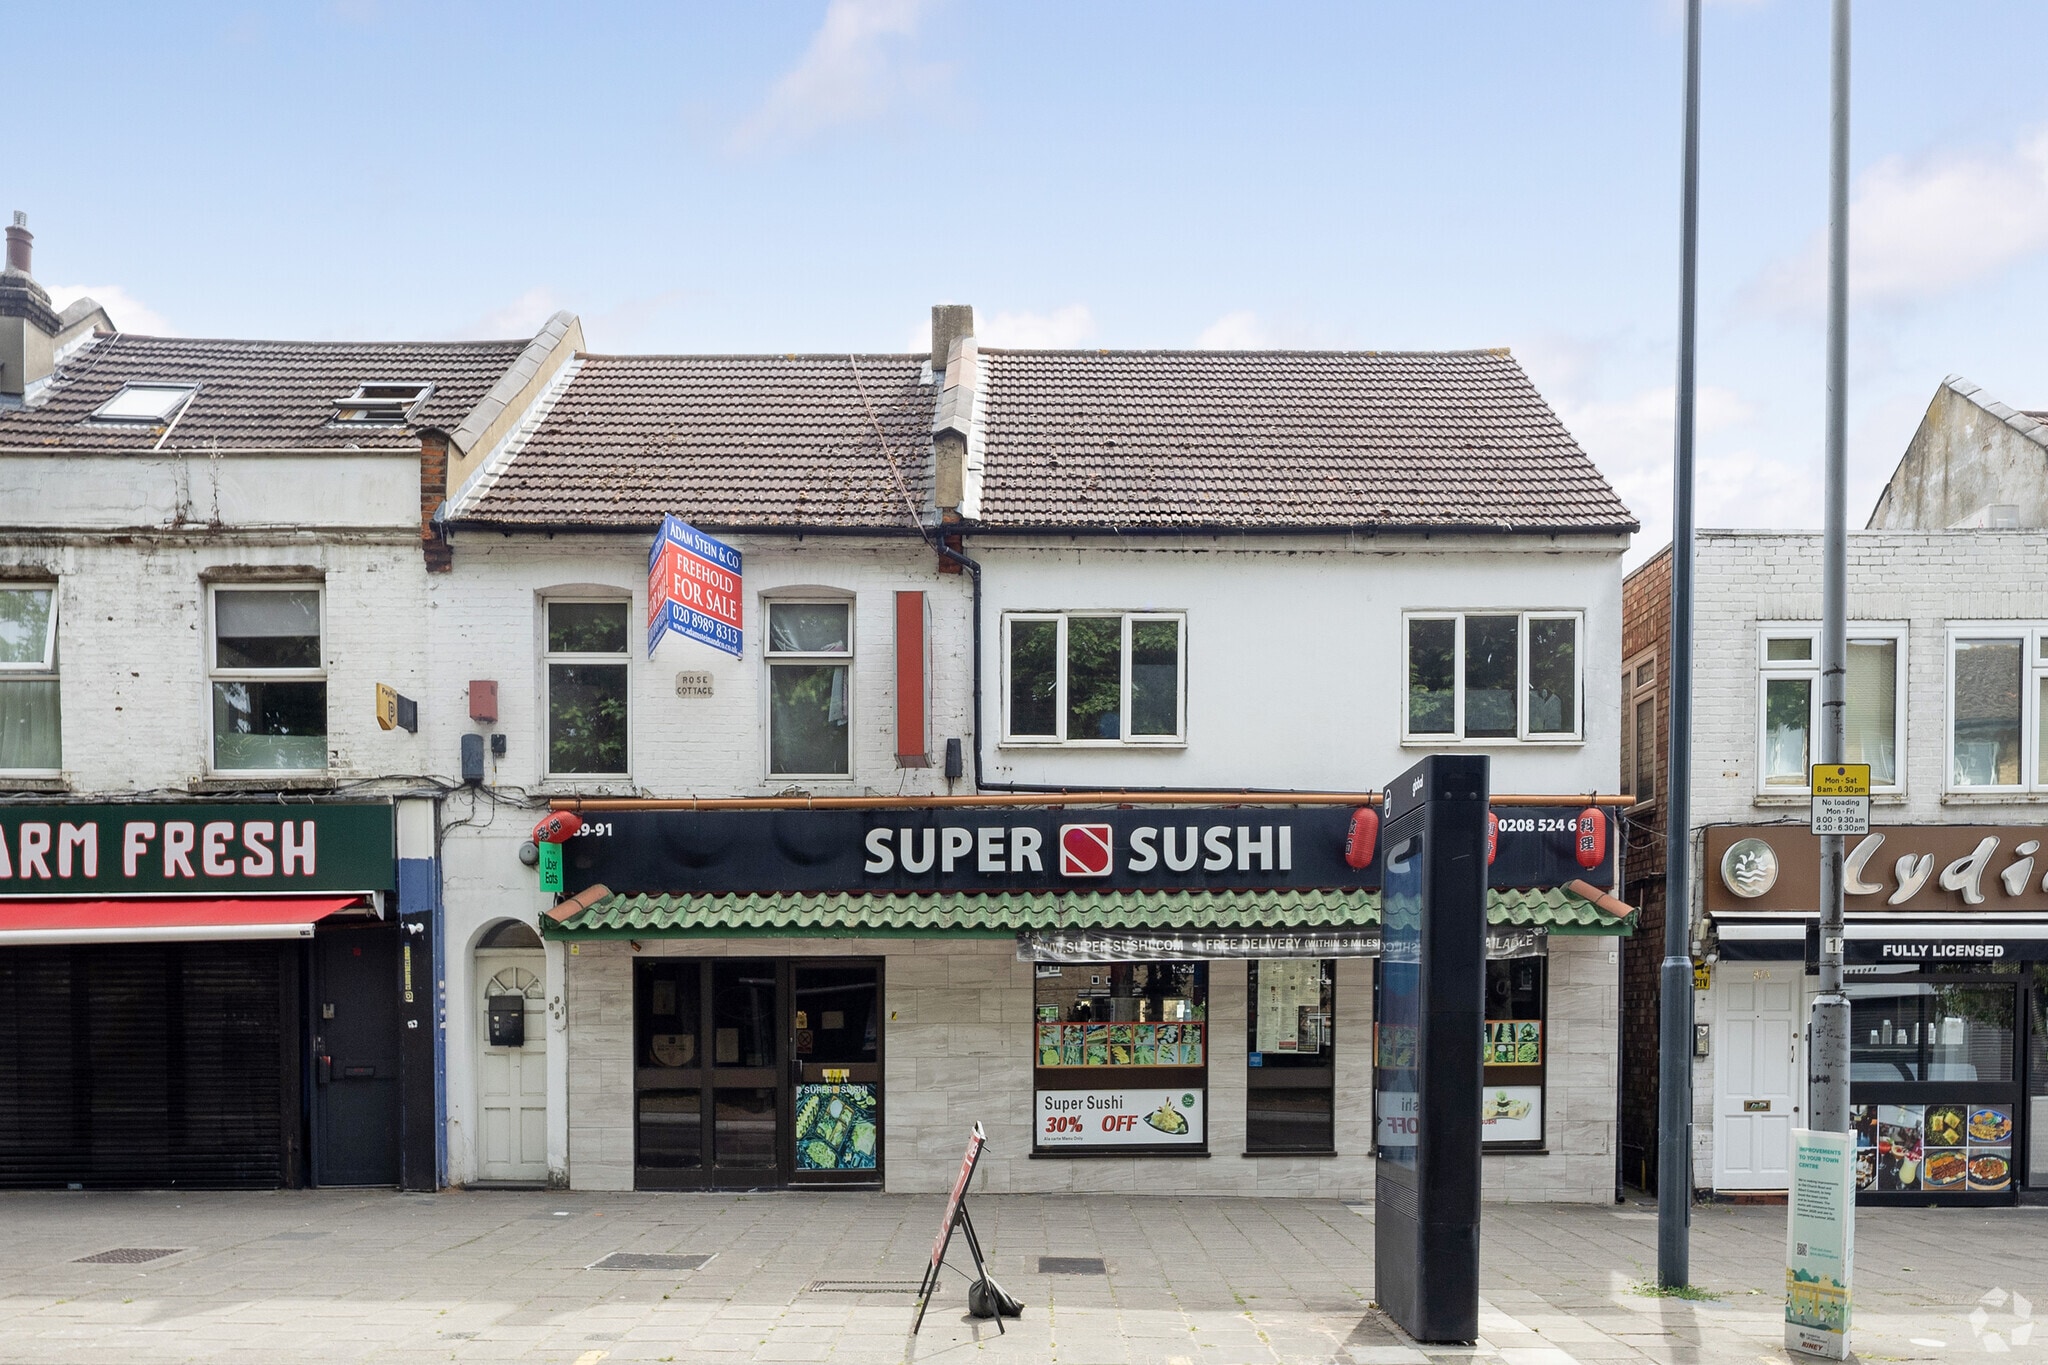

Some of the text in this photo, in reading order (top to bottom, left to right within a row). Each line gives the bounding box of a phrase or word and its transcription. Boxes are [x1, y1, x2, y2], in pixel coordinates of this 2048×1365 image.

[670, 521, 739, 569] ADAM STEIN & CO
[677, 553, 733, 593] FREEHOLD
[674, 573, 704, 607] FOR
[706, 589, 737, 621] SALE
[673, 604, 690, 624] 020
[692, 612, 714, 634] 8989
[716, 623, 738, 644] 8313
[682, 676, 708, 684] ROSE
[677, 686, 713, 696] COTTAGE
[1834, 799, 1860, 807] loading
[1498, 818, 1535, 832] 0208
[1537, 818, 1565, 832] 524
[123, 820, 316, 879] FRESH
[864, 827, 1044, 874] SUPER
[1128, 825, 1292, 872] SUSHI
[545, 857, 557, 870] Uber
[1844, 832, 2048, 905] Lydi
[545, 871, 558, 884] Eats
[1206, 939, 1238, 950] FREE
[1243, 938, 1302, 950] DELIVERY
[1304, 938, 1340, 948] (WITHIN
[1883, 945, 2005, 957] FULLY LICENSED
[1695, 978, 1708, 987] CTV
[804, 1085, 868, 1094] SUPER SUSHI
[1045, 1095, 1123, 1113] Super Sushi
[1045, 1114, 1138, 1133] 30% OFF
[1799, 1147, 1841, 1155] IMPROVEMENTS
